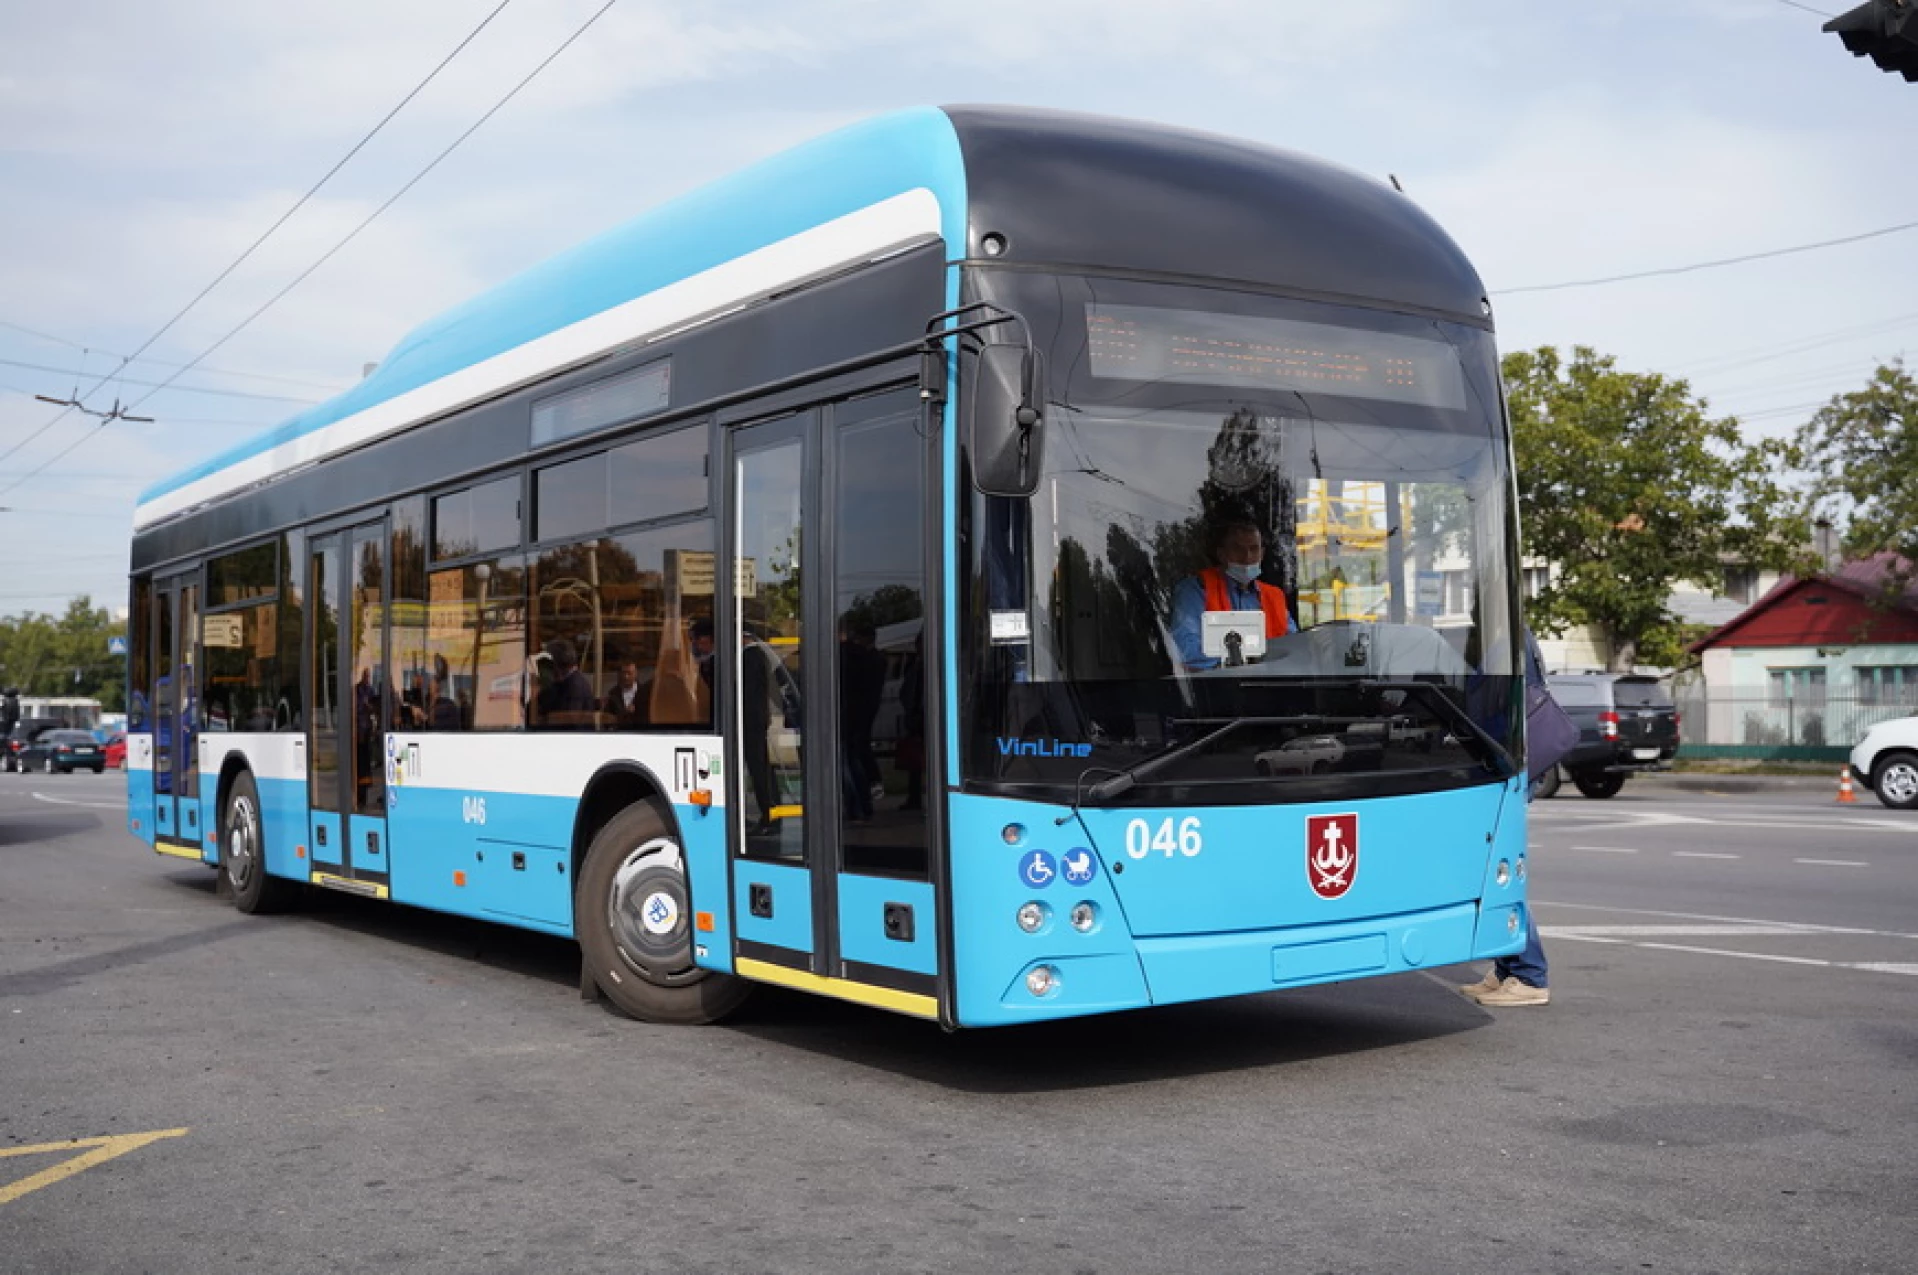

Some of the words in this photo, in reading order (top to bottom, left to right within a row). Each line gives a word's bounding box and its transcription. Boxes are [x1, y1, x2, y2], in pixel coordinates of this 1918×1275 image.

[996, 737, 1092, 757] VinLine
[463, 796, 486, 825] 046
[1126, 816, 1202, 859] 046
